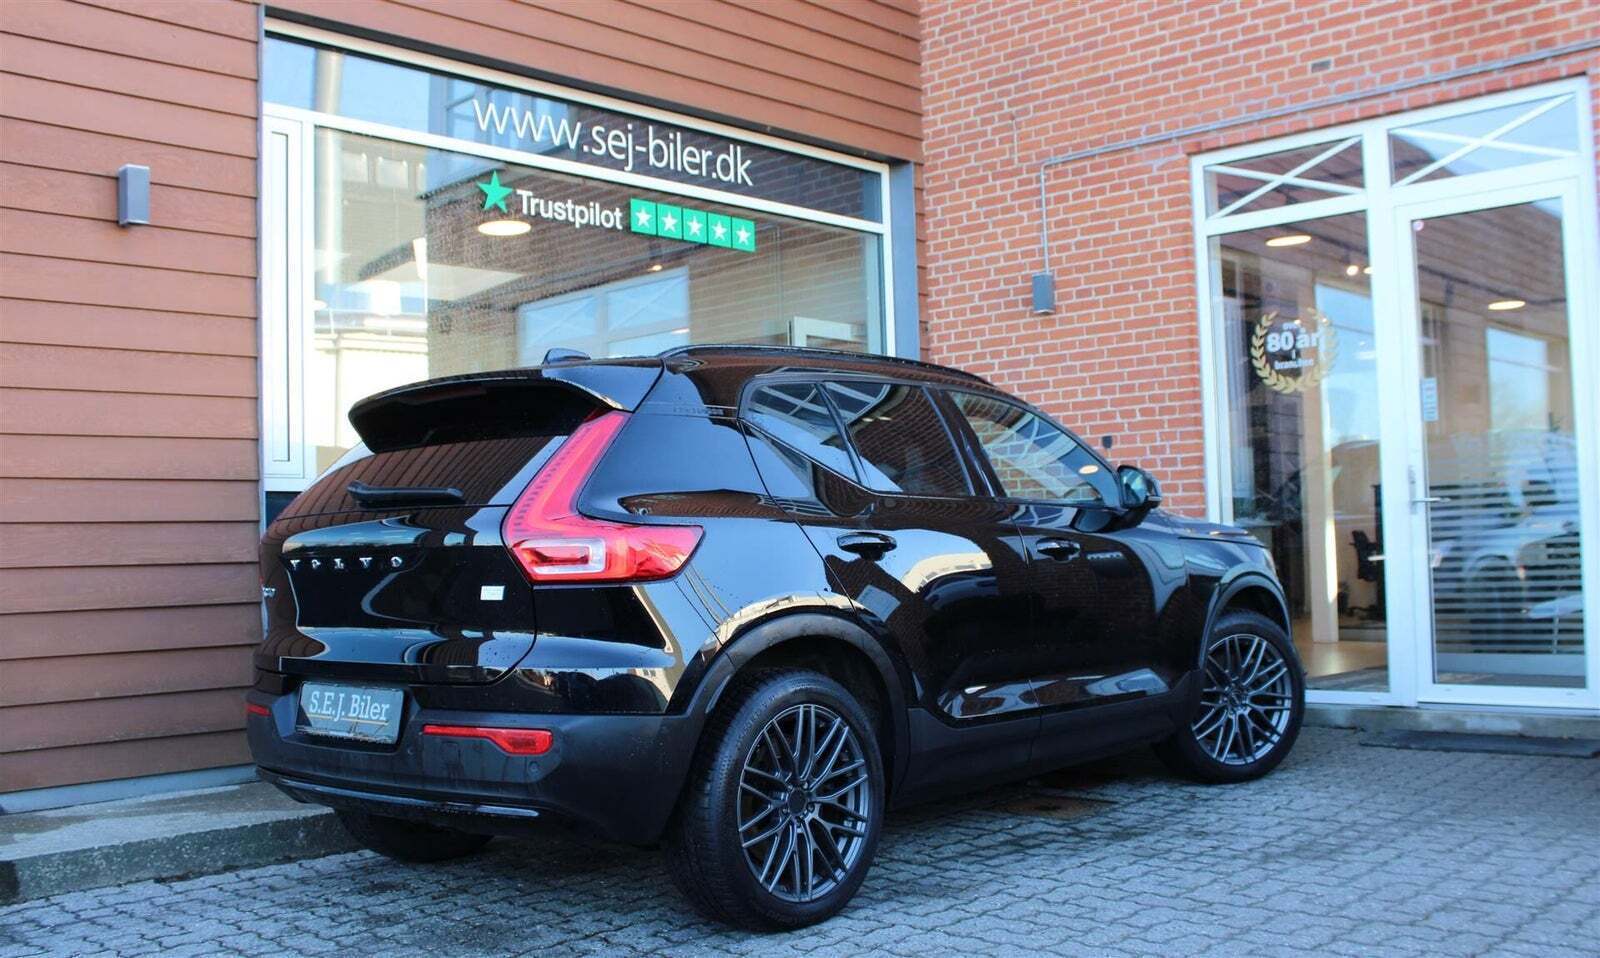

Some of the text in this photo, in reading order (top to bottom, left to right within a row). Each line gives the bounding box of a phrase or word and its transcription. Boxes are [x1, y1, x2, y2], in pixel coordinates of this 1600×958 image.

[473, 100, 753, 186] www.sej-biler.dk
[516, 189, 622, 230] Trustpilot
[1267, 332, 1294, 352] 80
[310, 691, 390, 721] S.E.J. Biler
